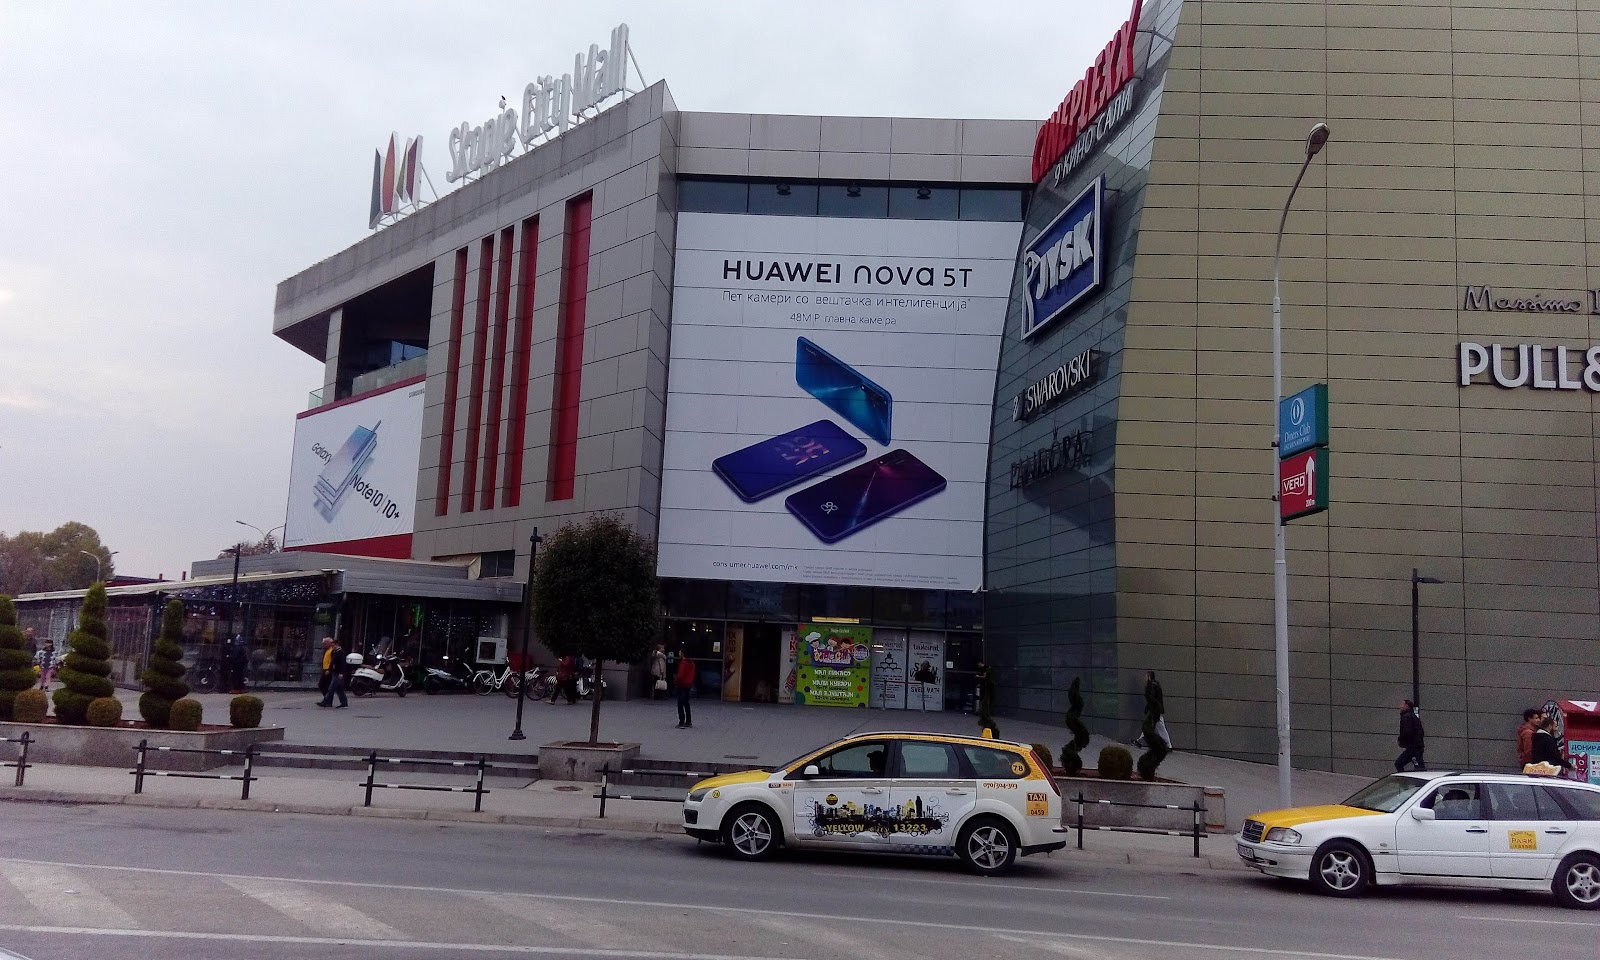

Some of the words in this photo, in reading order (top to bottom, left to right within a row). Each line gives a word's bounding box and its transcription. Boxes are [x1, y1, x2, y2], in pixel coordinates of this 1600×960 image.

[446, 97, 518, 183] Skopje
[521, 73, 571, 145] City
[572, 22, 629, 117] Mall
[1032, 0, 1143, 183] CINEPLEXX
[1062, 128, 1096, 177] КИНО
[1096, 83, 1135, 141] САЛИ
[1035, 211, 1094, 300] JYSK
[723, 259, 841, 284] HUAWEI
[853, 265, 934, 287] nova
[943, 267, 973, 288] 5T
[722, 290, 743, 302] Пет
[747, 293, 792, 306] камери
[796, 295, 809, 305] со
[815, 295, 872, 307] вештачка
[1465, 284, 1582, 312] Massimo
[824, 314, 856, 324] главна
[859, 316, 897, 326] камера
[1026, 349, 1092, 413] SWAROVSKI
[311, 442, 332, 465] Galaxy
[1283, 474, 1305, 492] VERO
[1028, 793, 1047, 801] TAXI
[826, 824, 865, 832] YELLOW
